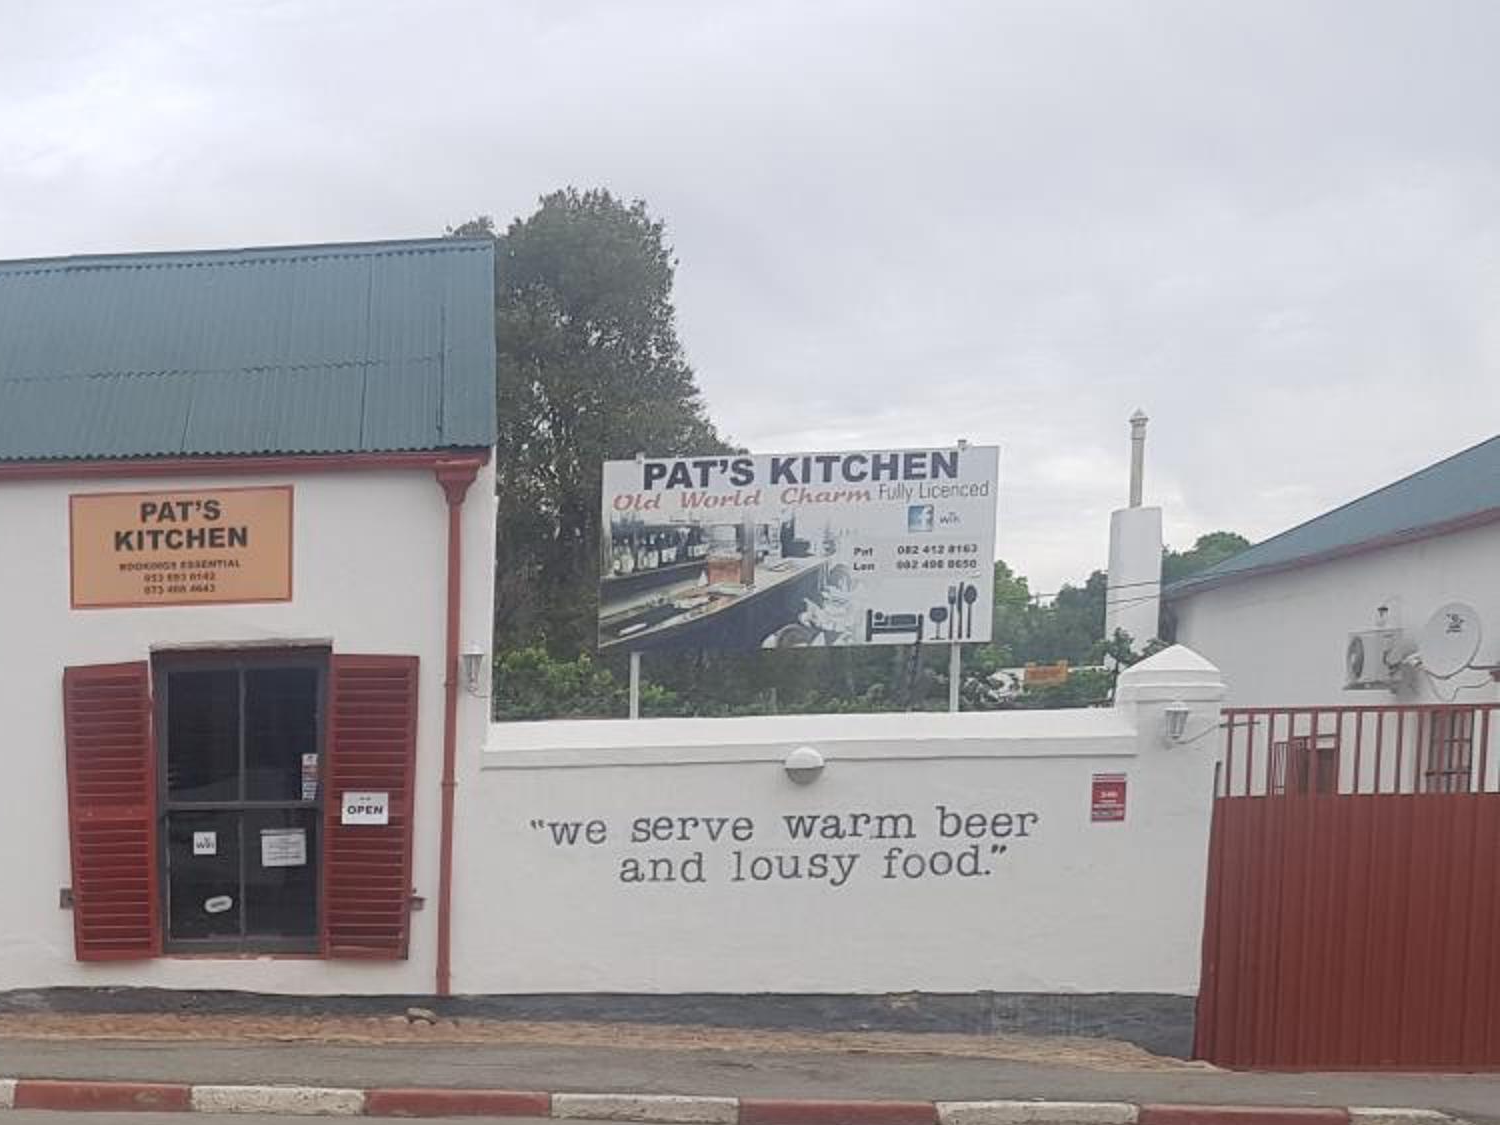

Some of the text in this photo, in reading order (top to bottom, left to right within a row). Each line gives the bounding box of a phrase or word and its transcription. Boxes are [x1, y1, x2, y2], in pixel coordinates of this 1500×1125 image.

[643, 451, 959, 490] PAT'S KITCHEN
[612, 487, 871, 511] Old World Charm
[879, 480, 990, 501] Fully Licenced
[114, 499, 248, 551] PAT'S KITCHEN
[180, 559, 240, 569] ESSENTIAL
[347, 805, 384, 815] OPEN
[631, 813, 755, 843] serve
[782, 809, 917, 840] warm
[935, 805, 1039, 839] beer
[619, 851, 707, 884] and
[731, 850, 861, 887] lousy
